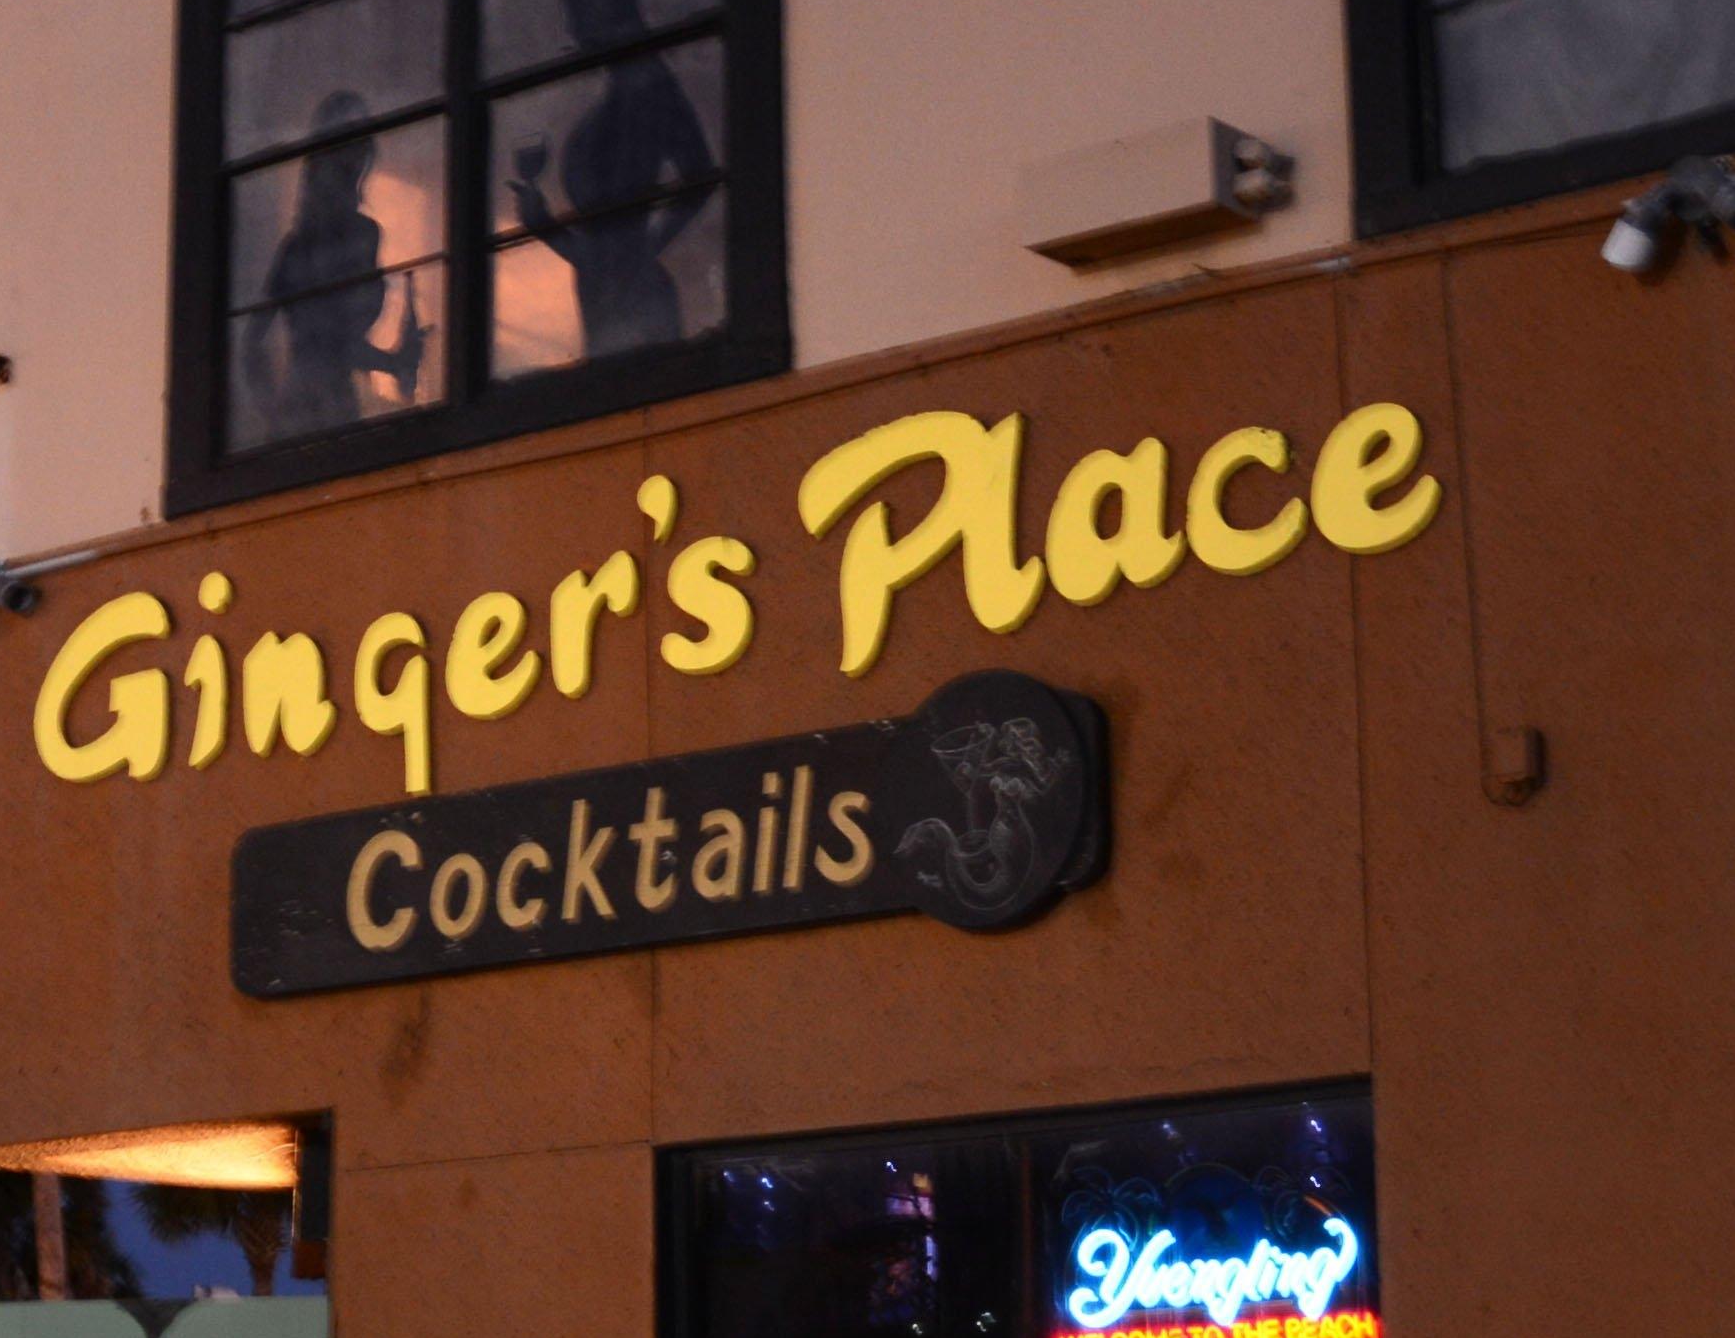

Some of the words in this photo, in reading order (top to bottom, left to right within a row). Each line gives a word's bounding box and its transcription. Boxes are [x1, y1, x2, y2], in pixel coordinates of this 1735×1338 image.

[32, 473, 756, 796] Ginger's
[797, 402, 1442, 677] Place
[345, 764, 875, 953] Cocktails
[1069, 1217, 1359, 1328] Yuengling
